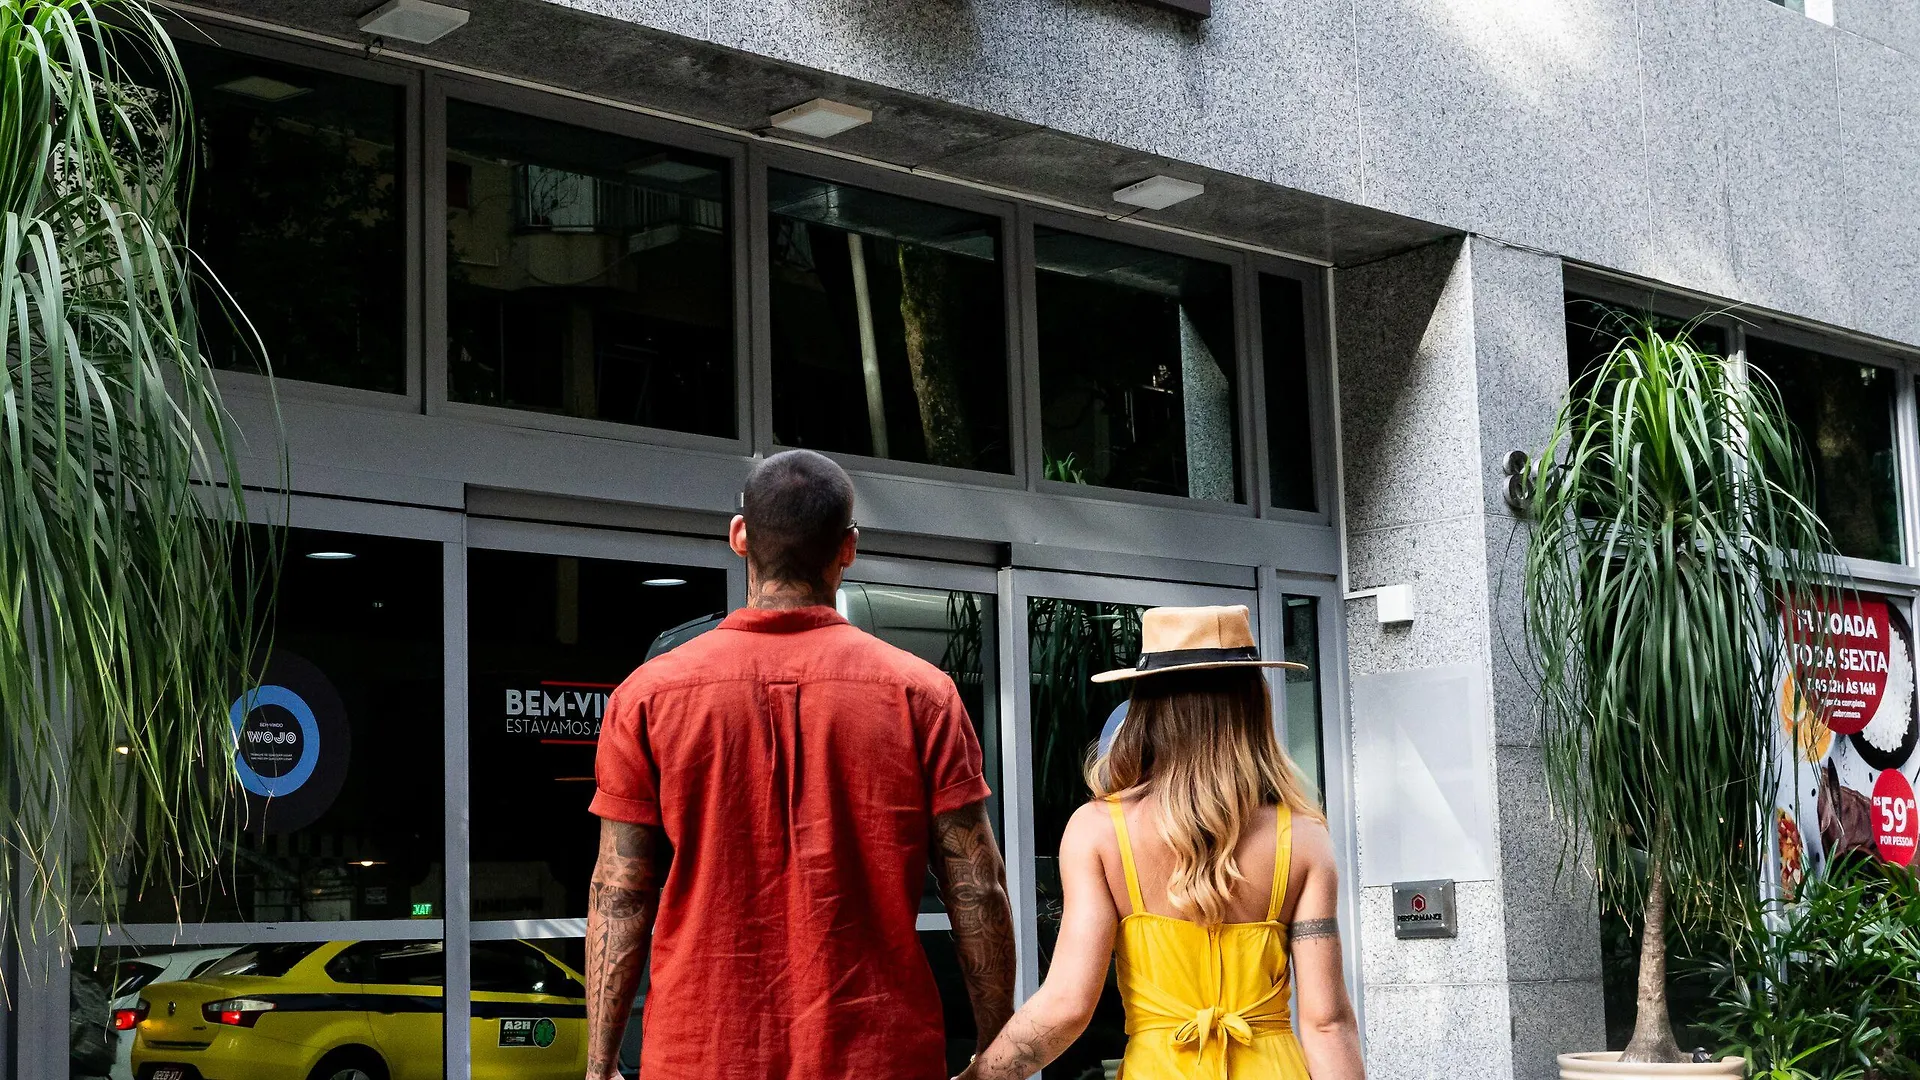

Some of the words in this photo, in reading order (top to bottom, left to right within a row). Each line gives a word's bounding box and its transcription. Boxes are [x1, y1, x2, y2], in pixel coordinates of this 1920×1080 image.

[1797, 608, 1878, 639] FIOADA
[1839, 647, 1888, 673] SEXTA
[1846, 677, 1858, 695] ÀS
[1859, 681, 1876, 695] 14H
[506, 716, 591, 735] ESTÁVAMOS
[247, 731, 296, 744] WOJO
[1880, 835, 1892, 845] POR
[1892, 836, 1914, 847] PESSOA
[1397, 913, 1443, 922] PERFORMANCE
